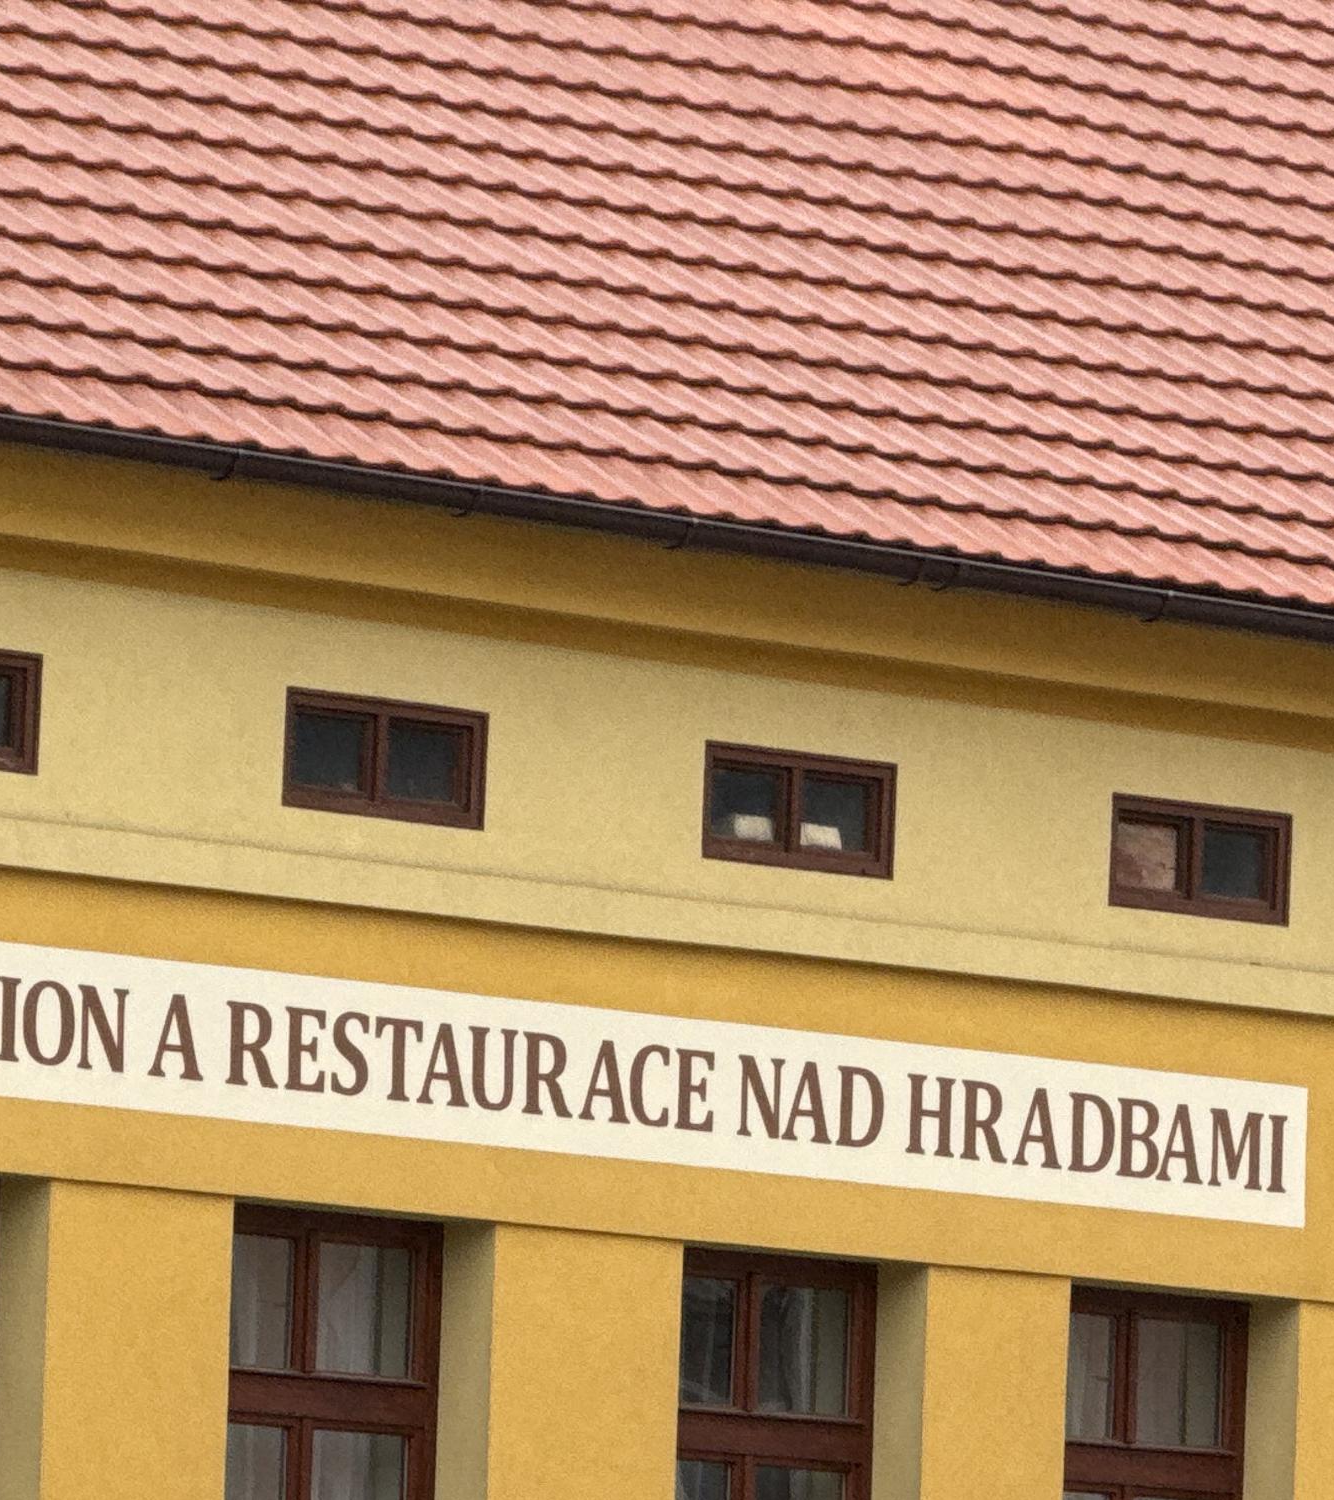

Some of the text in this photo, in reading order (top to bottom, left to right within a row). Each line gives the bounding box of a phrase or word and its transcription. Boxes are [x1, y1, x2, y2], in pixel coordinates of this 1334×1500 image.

[148, 993, 203, 1082] A
[225, 999, 716, 1133] RESTAURACE
[737, 1054, 885, 1149] NAD
[905, 1073, 1289, 1194] HRADBAMI
